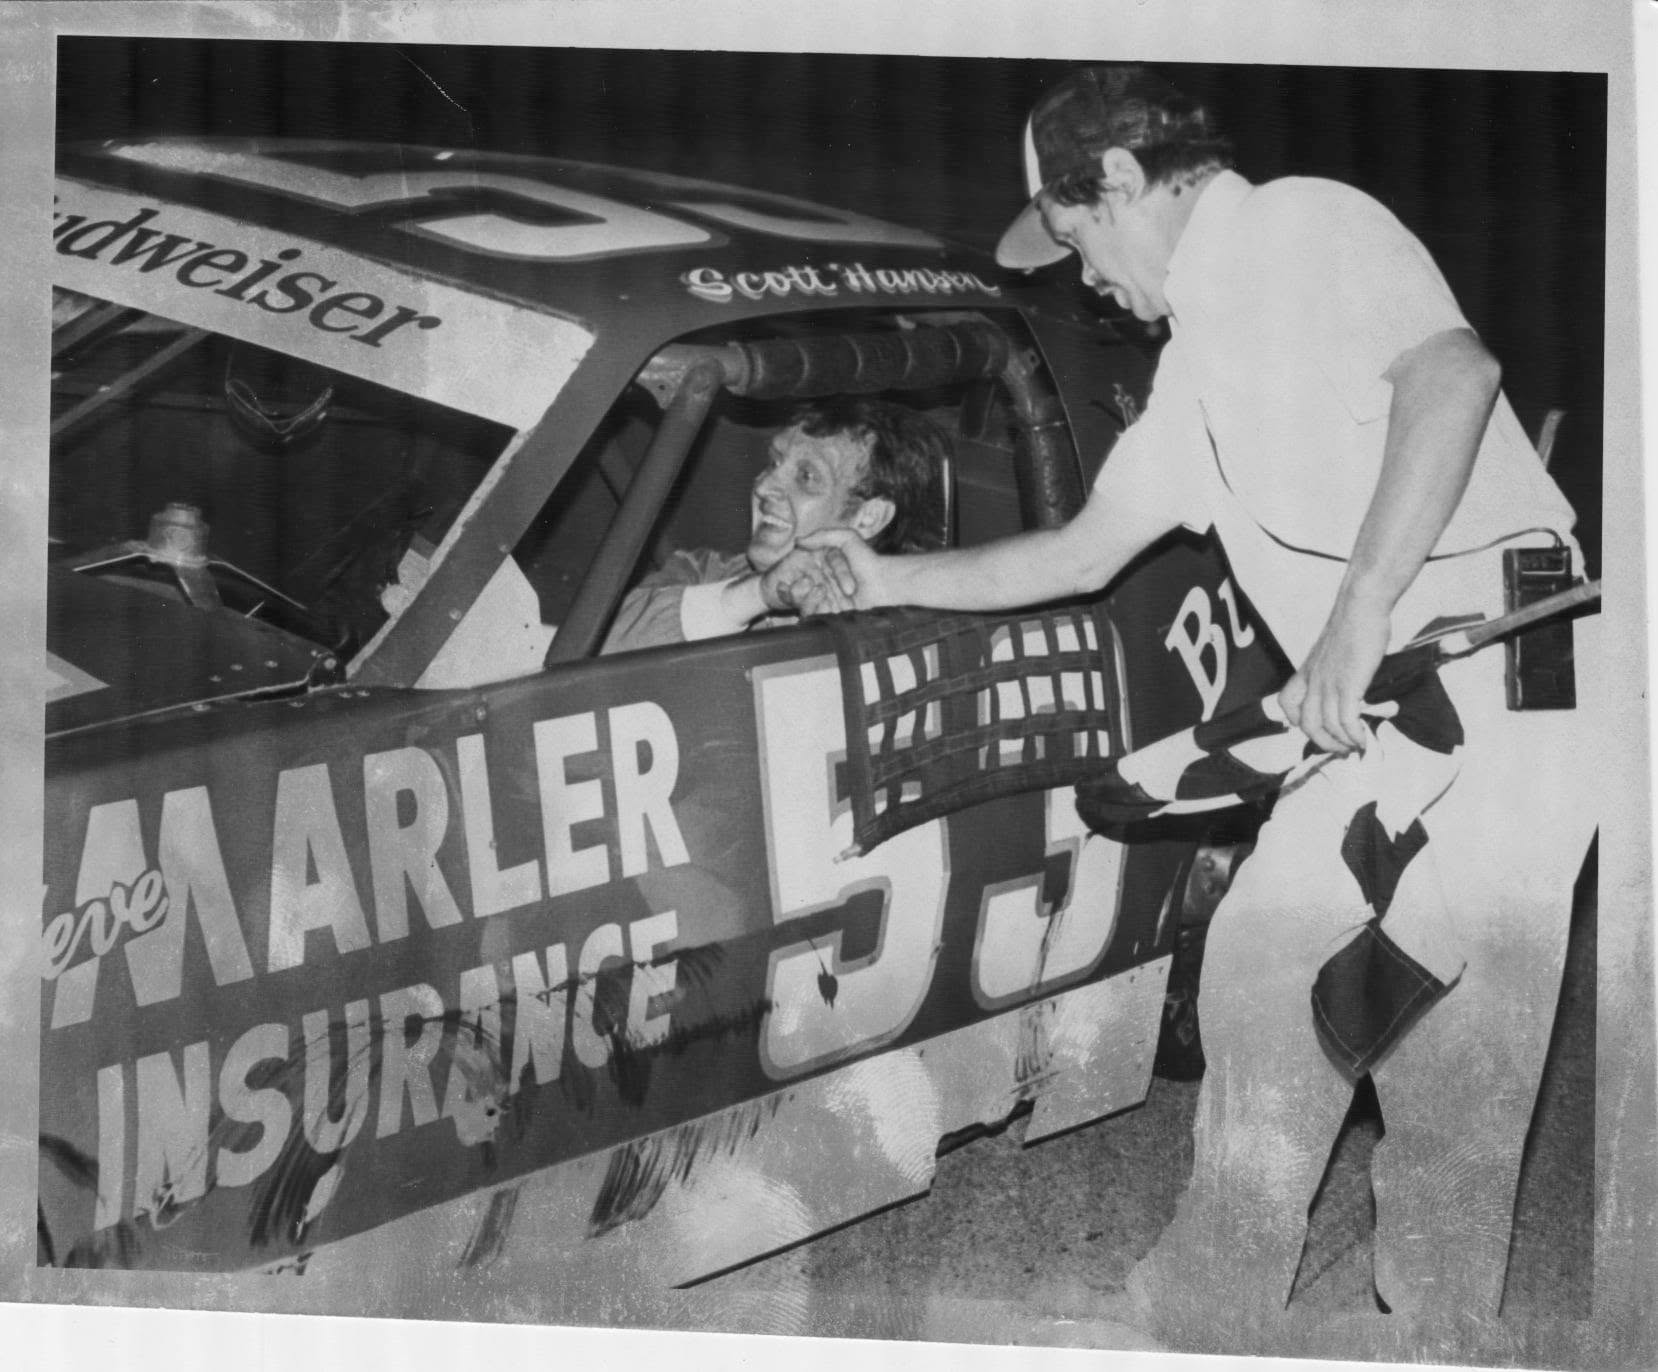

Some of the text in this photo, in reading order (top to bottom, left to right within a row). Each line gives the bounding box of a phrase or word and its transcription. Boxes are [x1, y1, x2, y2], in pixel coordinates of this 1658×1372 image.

[681, 266, 838, 303] Scott
[50, 701, 691, 1031] MARLER
[94, 910, 680, 1231] INSURANCE
